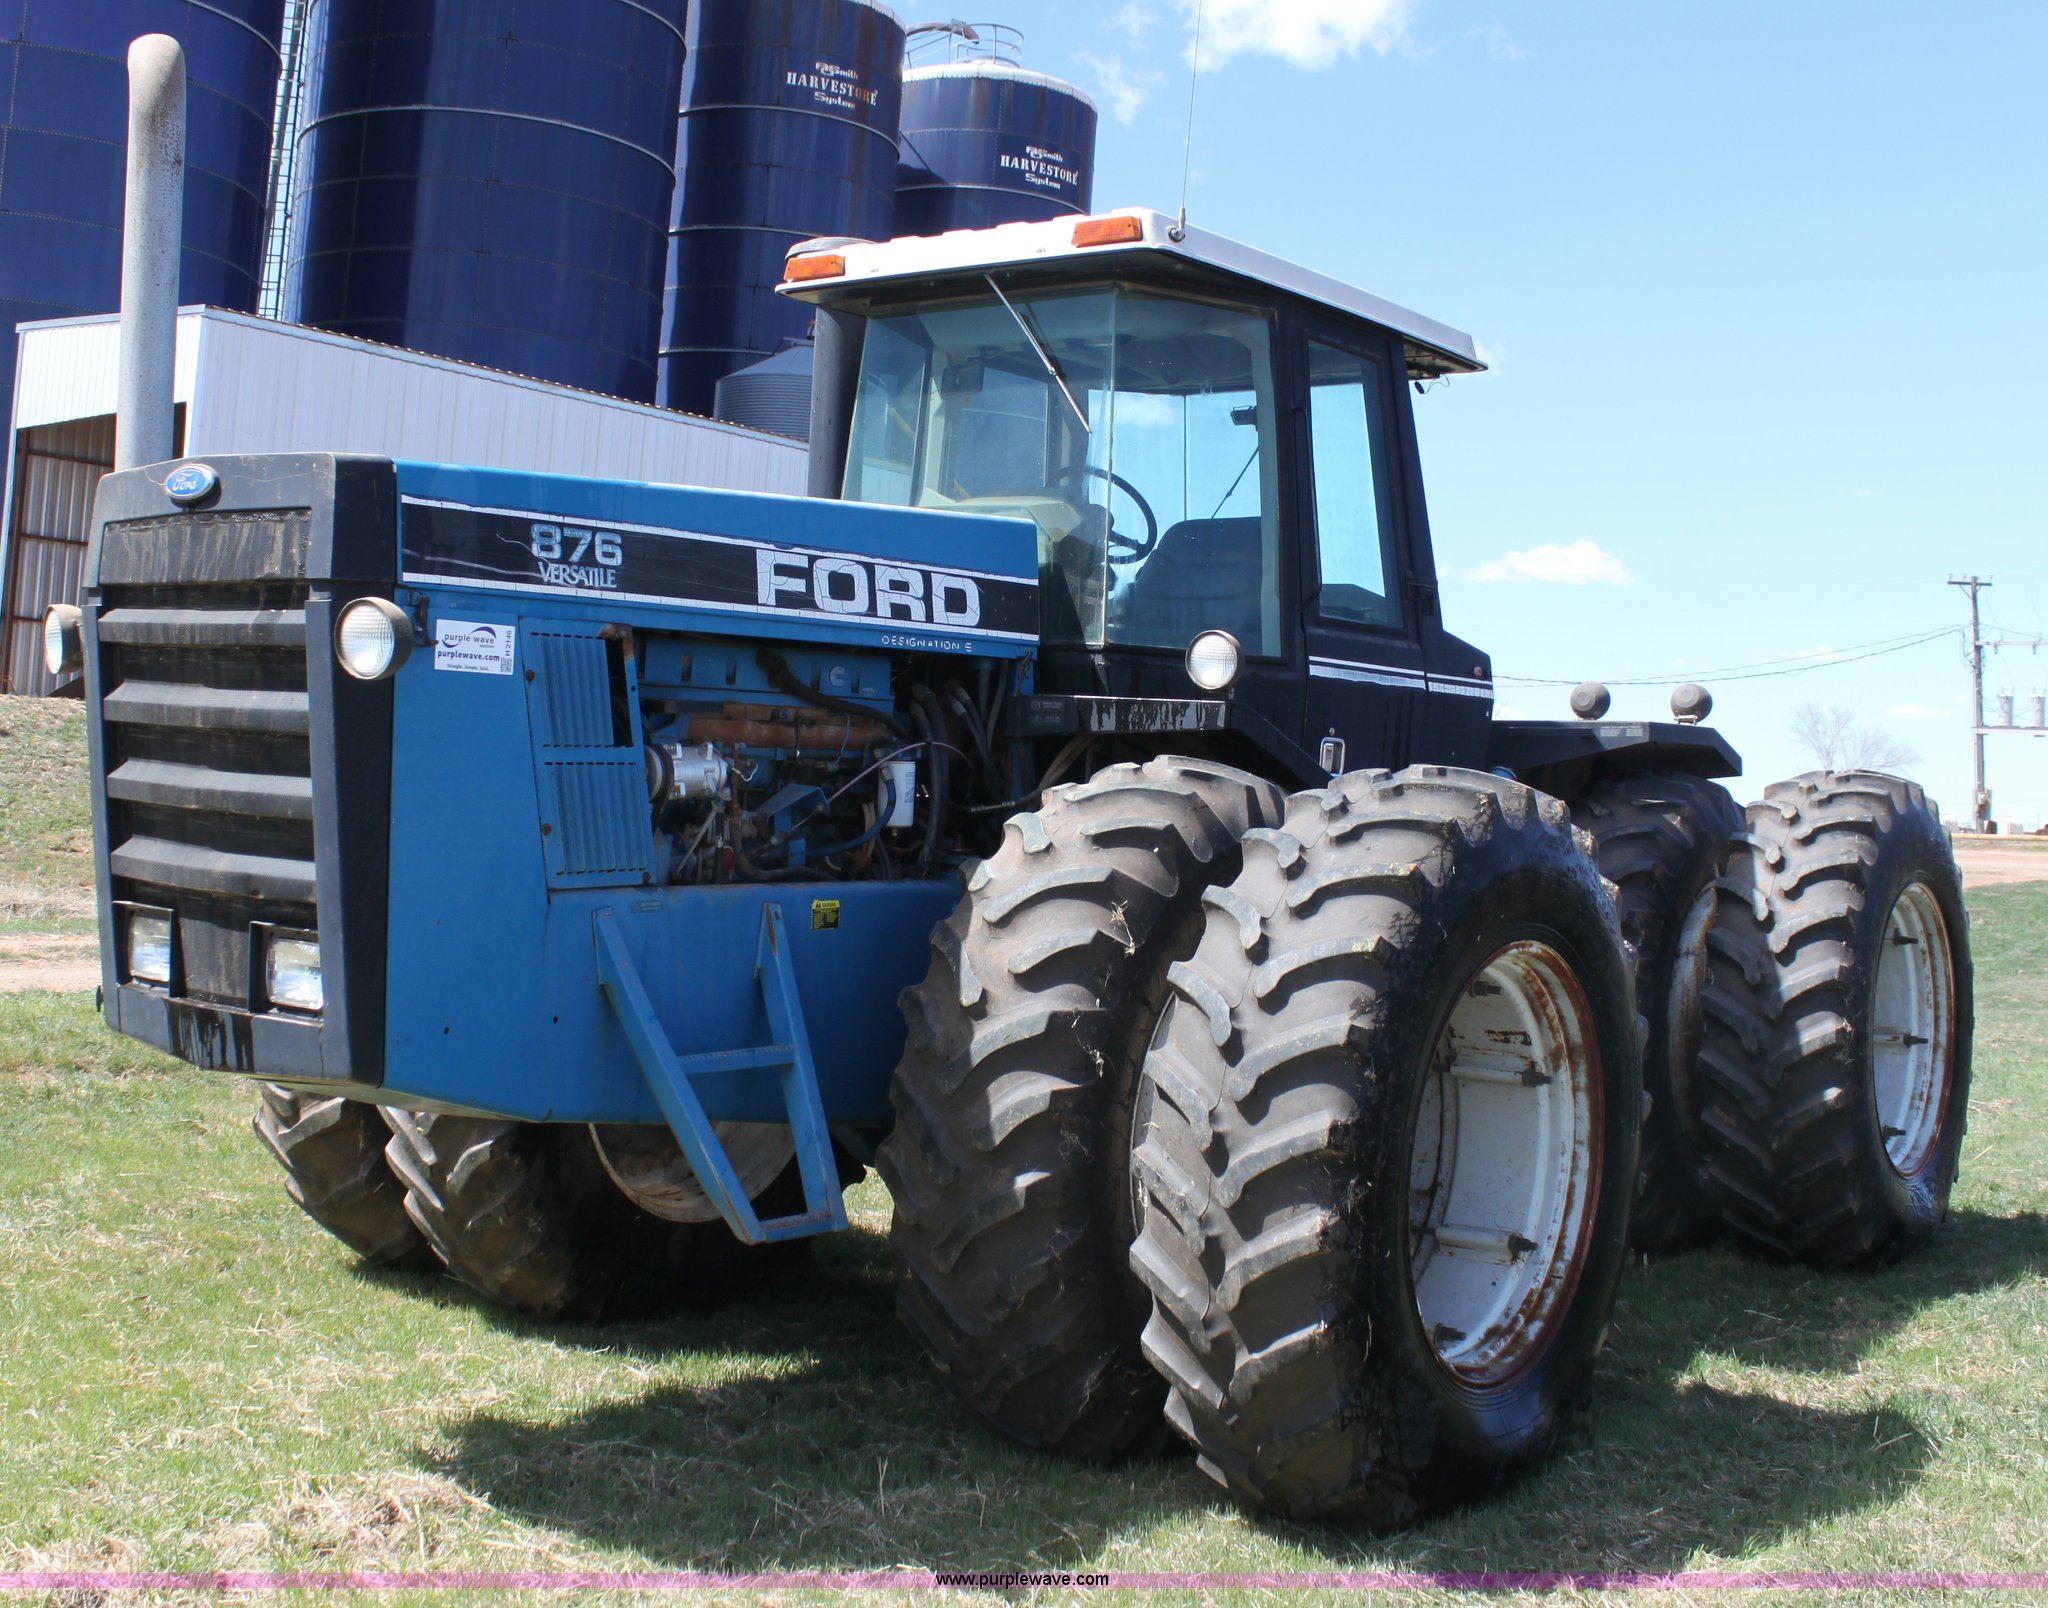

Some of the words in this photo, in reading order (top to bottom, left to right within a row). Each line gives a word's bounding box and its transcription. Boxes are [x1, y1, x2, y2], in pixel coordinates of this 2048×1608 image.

[786, 71, 879, 106] HARVESTORE
[814, 91, 856, 109] System
[1000, 154, 1079, 186] HARVESTORE
[1025, 172, 1061, 190] System
[531, 523, 623, 567] 876
[537, 561, 618, 589] VERSATILE
[755, 549, 981, 627] FORD
[444, 633, 471, 643] purple
[473, 636, 495, 644] wave
[881, 635, 960, 650] DESIGNATION
[437, 650, 500, 662] purplewave.com
